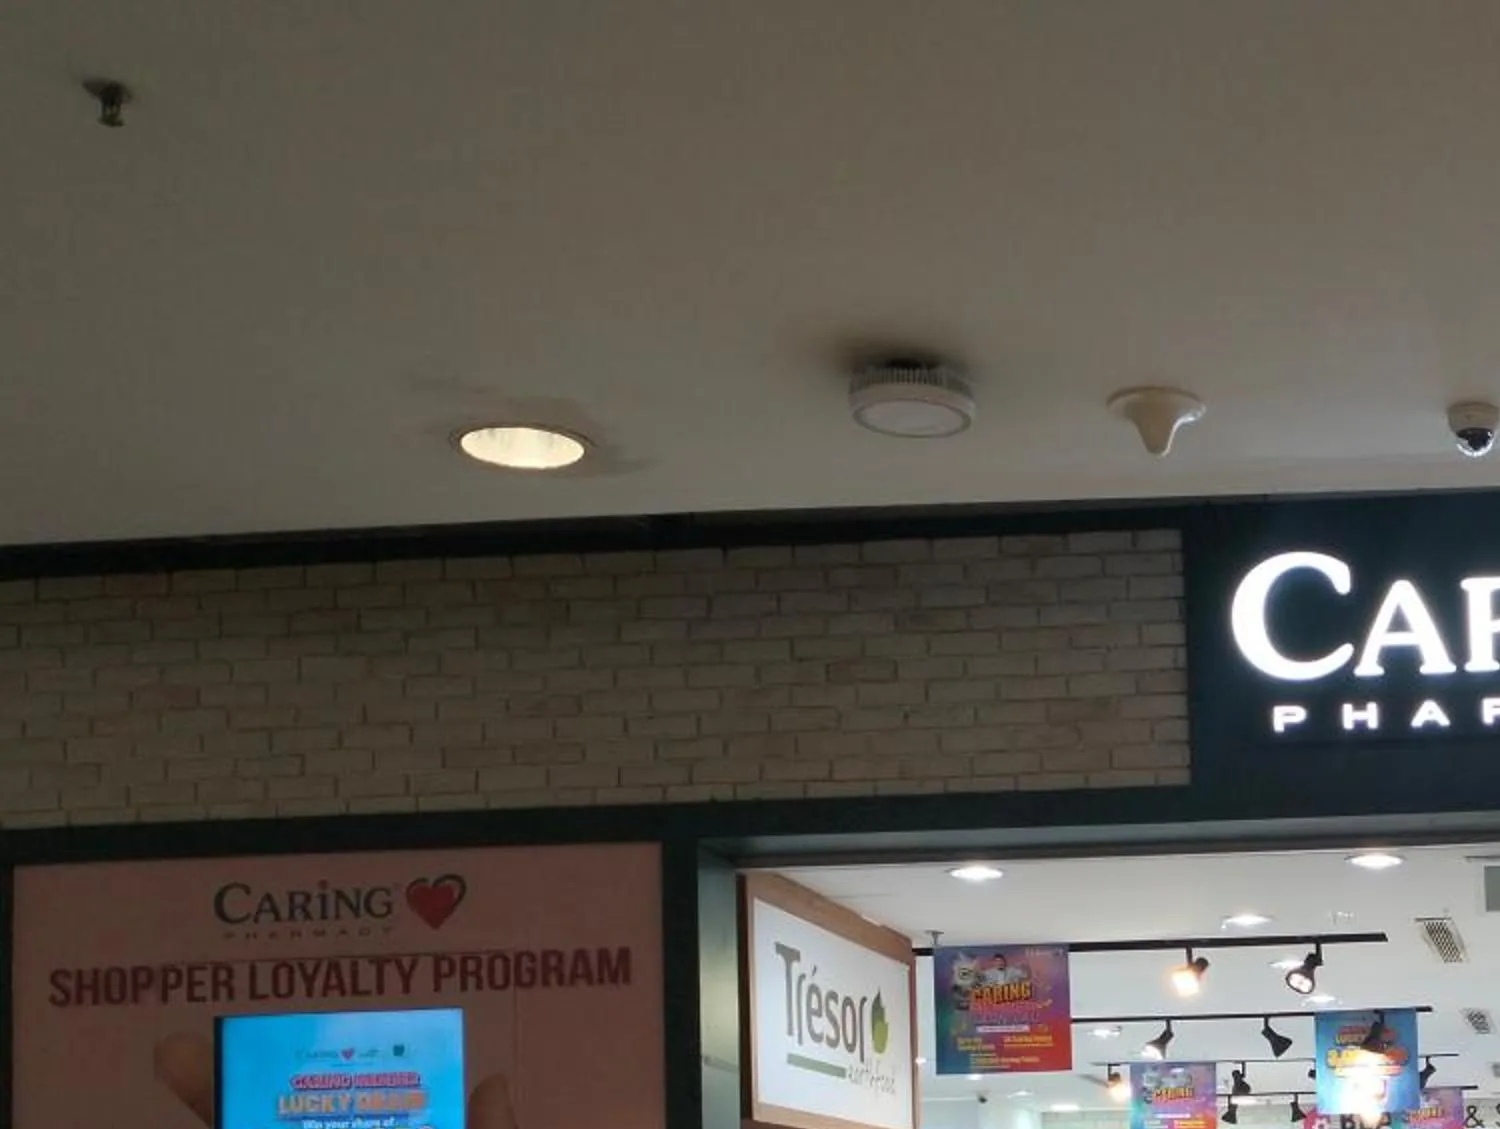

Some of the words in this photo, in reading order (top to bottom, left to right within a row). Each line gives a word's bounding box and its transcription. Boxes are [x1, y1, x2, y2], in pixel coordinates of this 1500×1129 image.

[49, 963, 235, 1009] SHOPPER
[248, 954, 422, 1001] LOYALTY
[432, 947, 634, 994] PROGRAM
[774, 941, 869, 1063] Trésor
[277, 1092, 351, 1115] LUCKY
